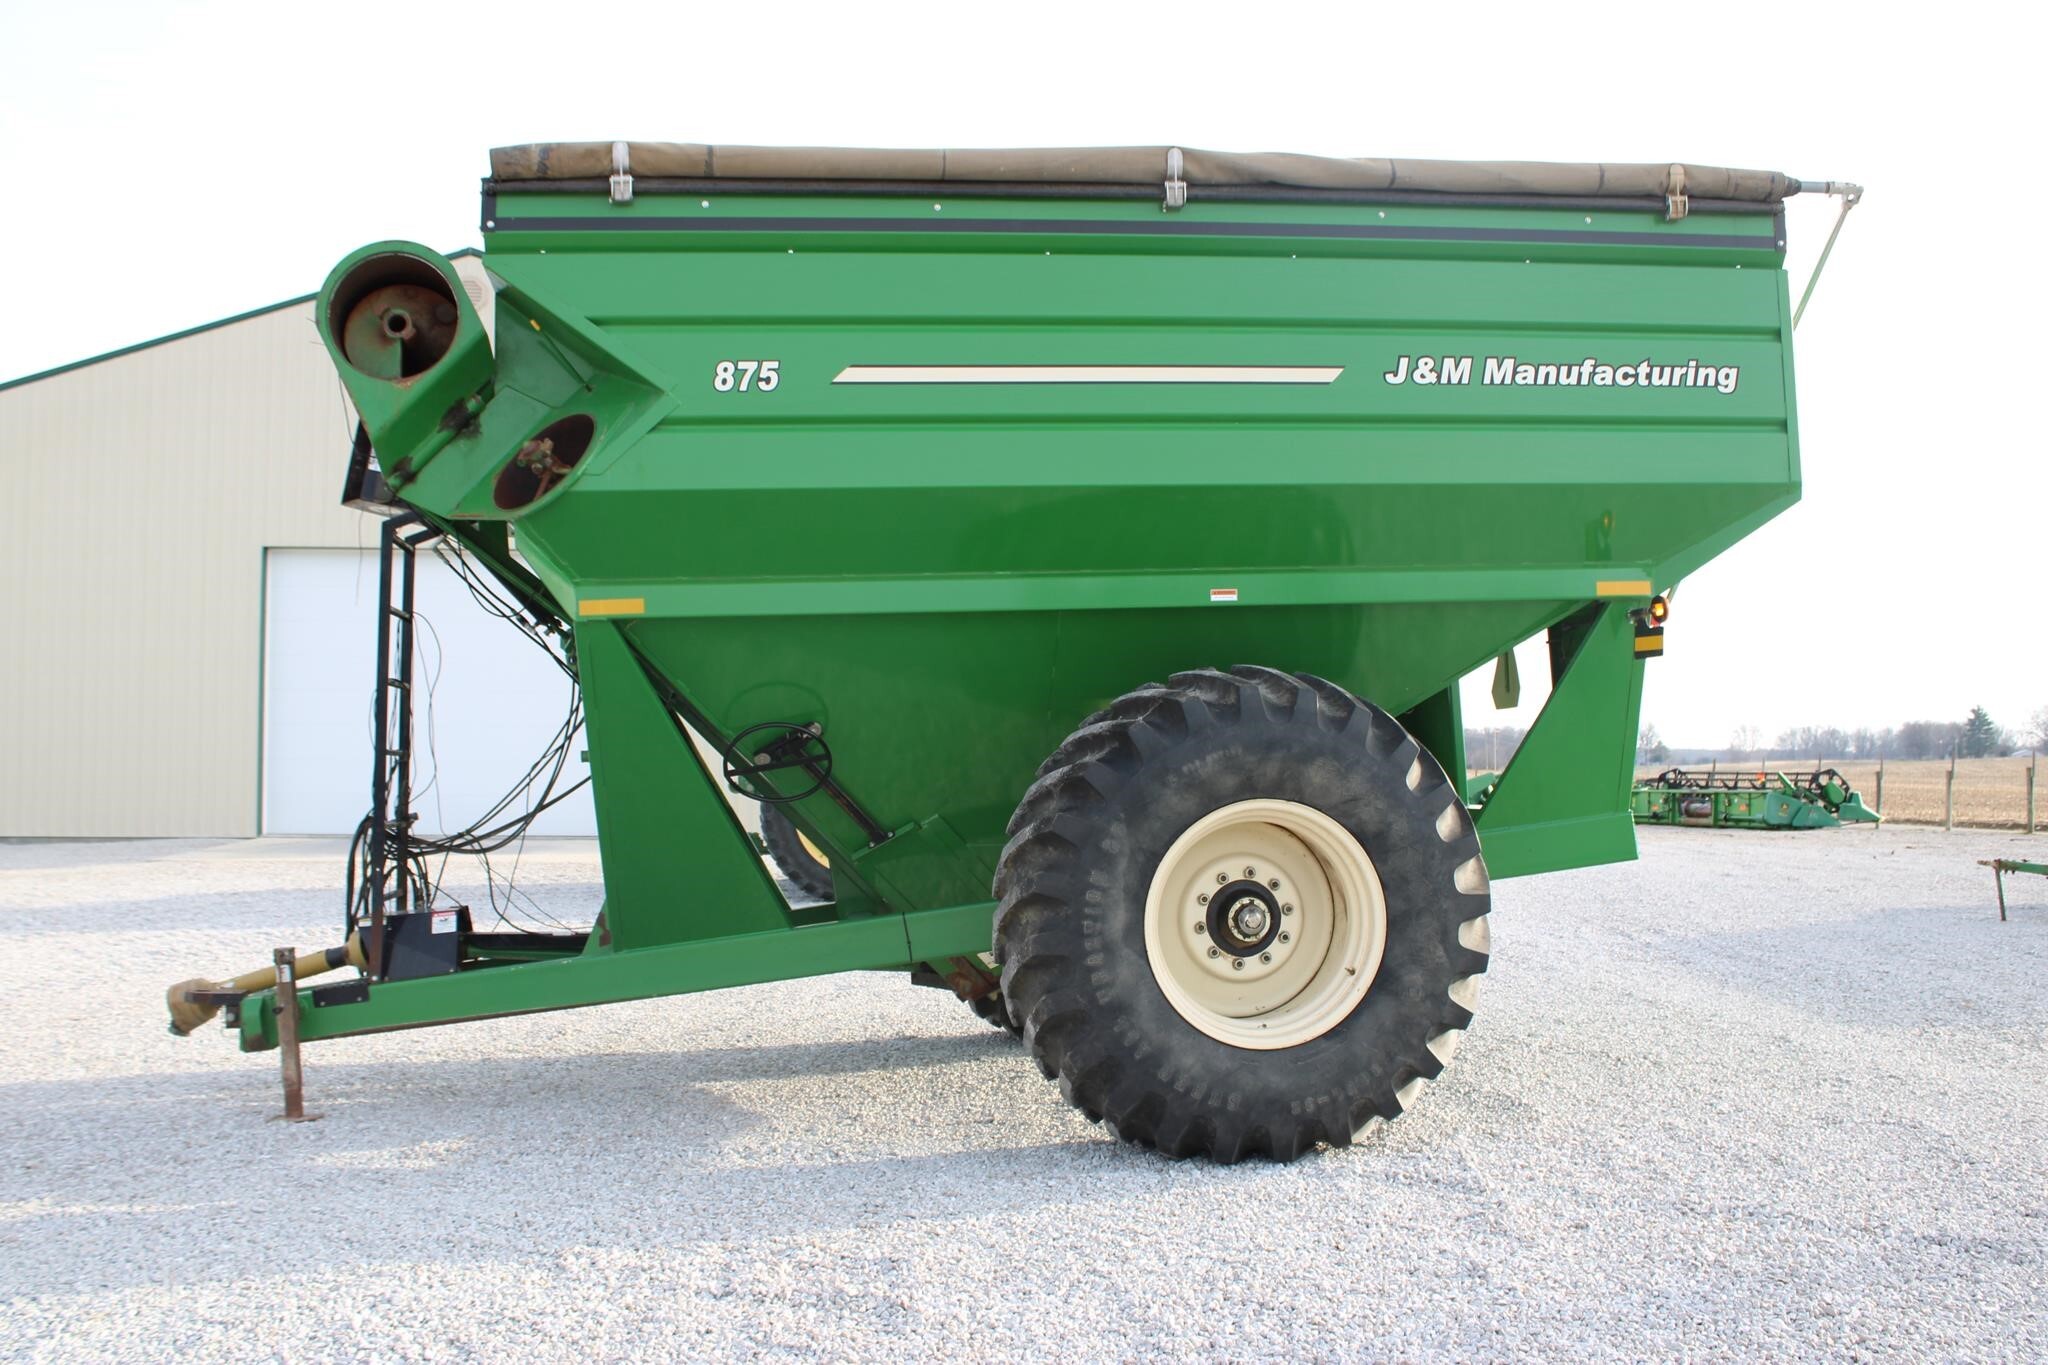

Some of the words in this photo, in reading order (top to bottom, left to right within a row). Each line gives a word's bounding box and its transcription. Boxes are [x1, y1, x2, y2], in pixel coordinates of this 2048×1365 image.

[713, 359, 780, 392] 875
[1383, 355, 1473, 386] J&M
[1482, 356, 1739, 394] Manufacturing
